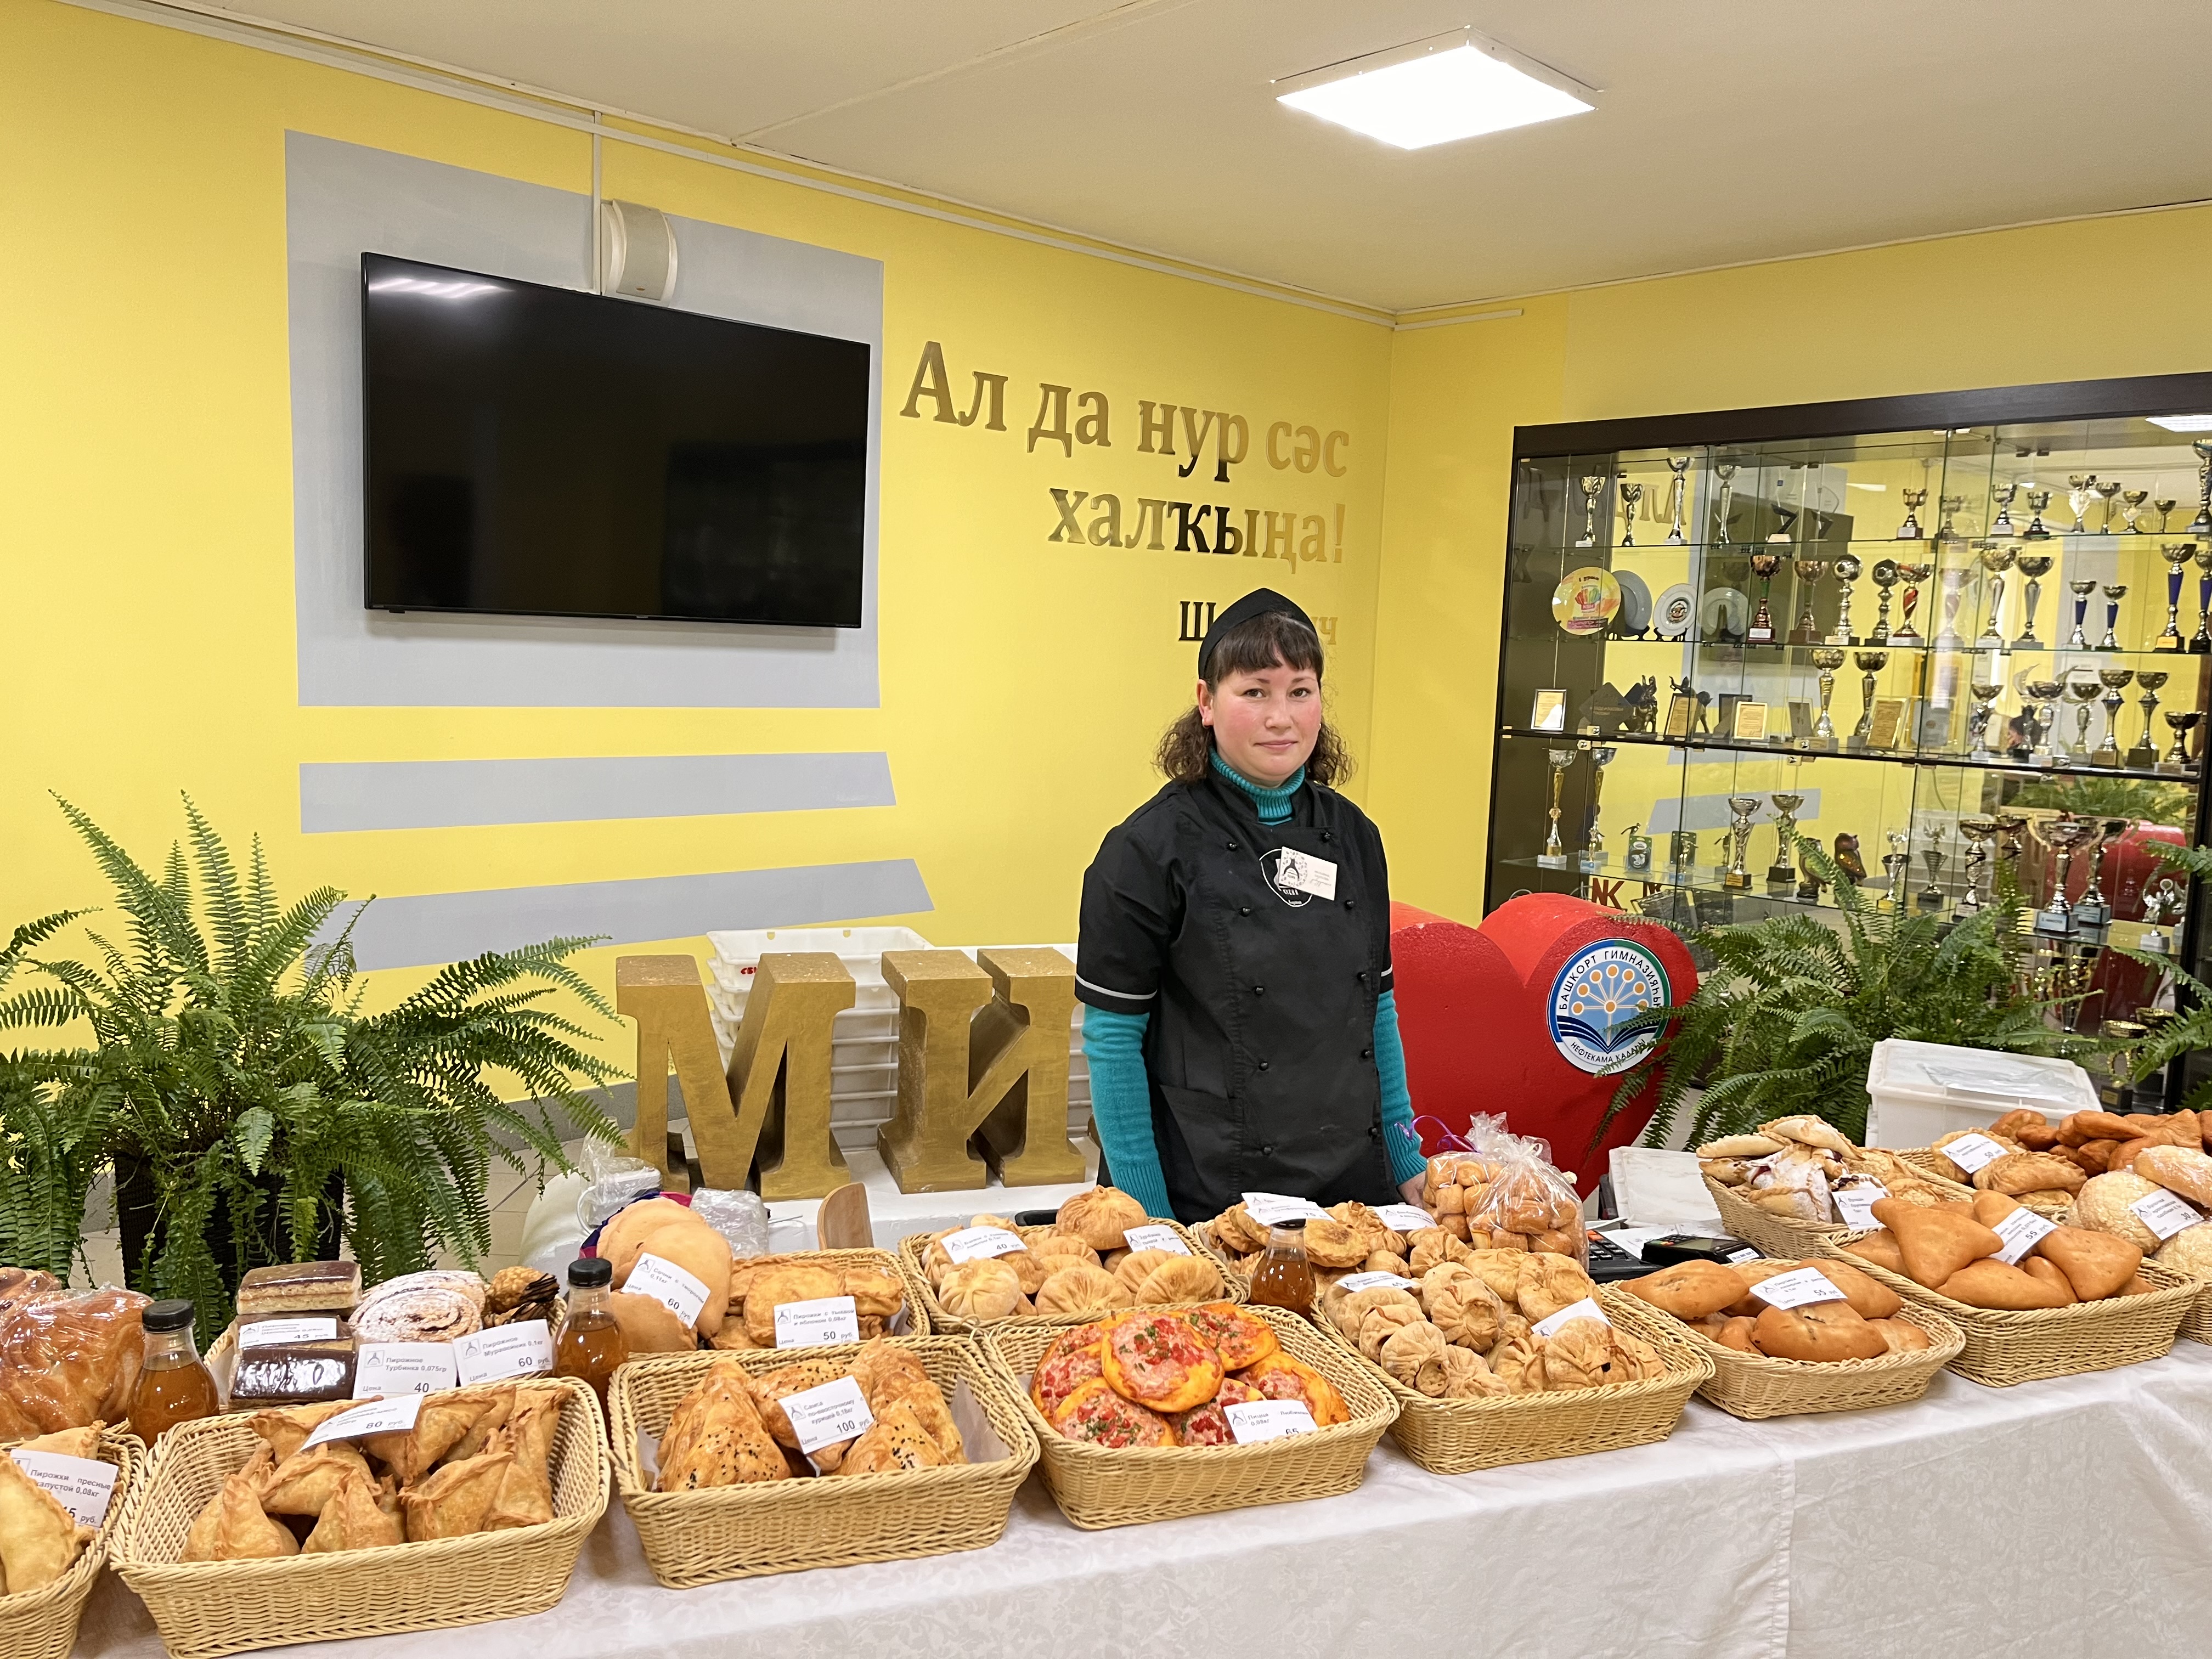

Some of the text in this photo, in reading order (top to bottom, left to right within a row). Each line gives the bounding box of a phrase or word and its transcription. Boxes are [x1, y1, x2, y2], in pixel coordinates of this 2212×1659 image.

[900, 341, 1350, 482] Ал да нур сәс
[1048, 487, 1346, 575] халҡыңа!
[1571, 1042, 1613, 1063] НЕФТЕКАМА
[2025, 1231, 2038, 1239] 55
[668, 1298, 680, 1310] 60
[823, 1331, 836, 1340] 50
[483, 1337, 518, 1350] Пирожное
[518, 1356, 533, 1367] 60
[414, 1383, 430, 1393] 40
[366, 1421, 383, 1429] 80
[837, 1420, 855, 1434] 100
[30, 1469, 111, 1490] Пирожки пресные
[76, 1487, 99, 1497] 0,08кг
[63, 1506, 97, 1524] 5 руб.
